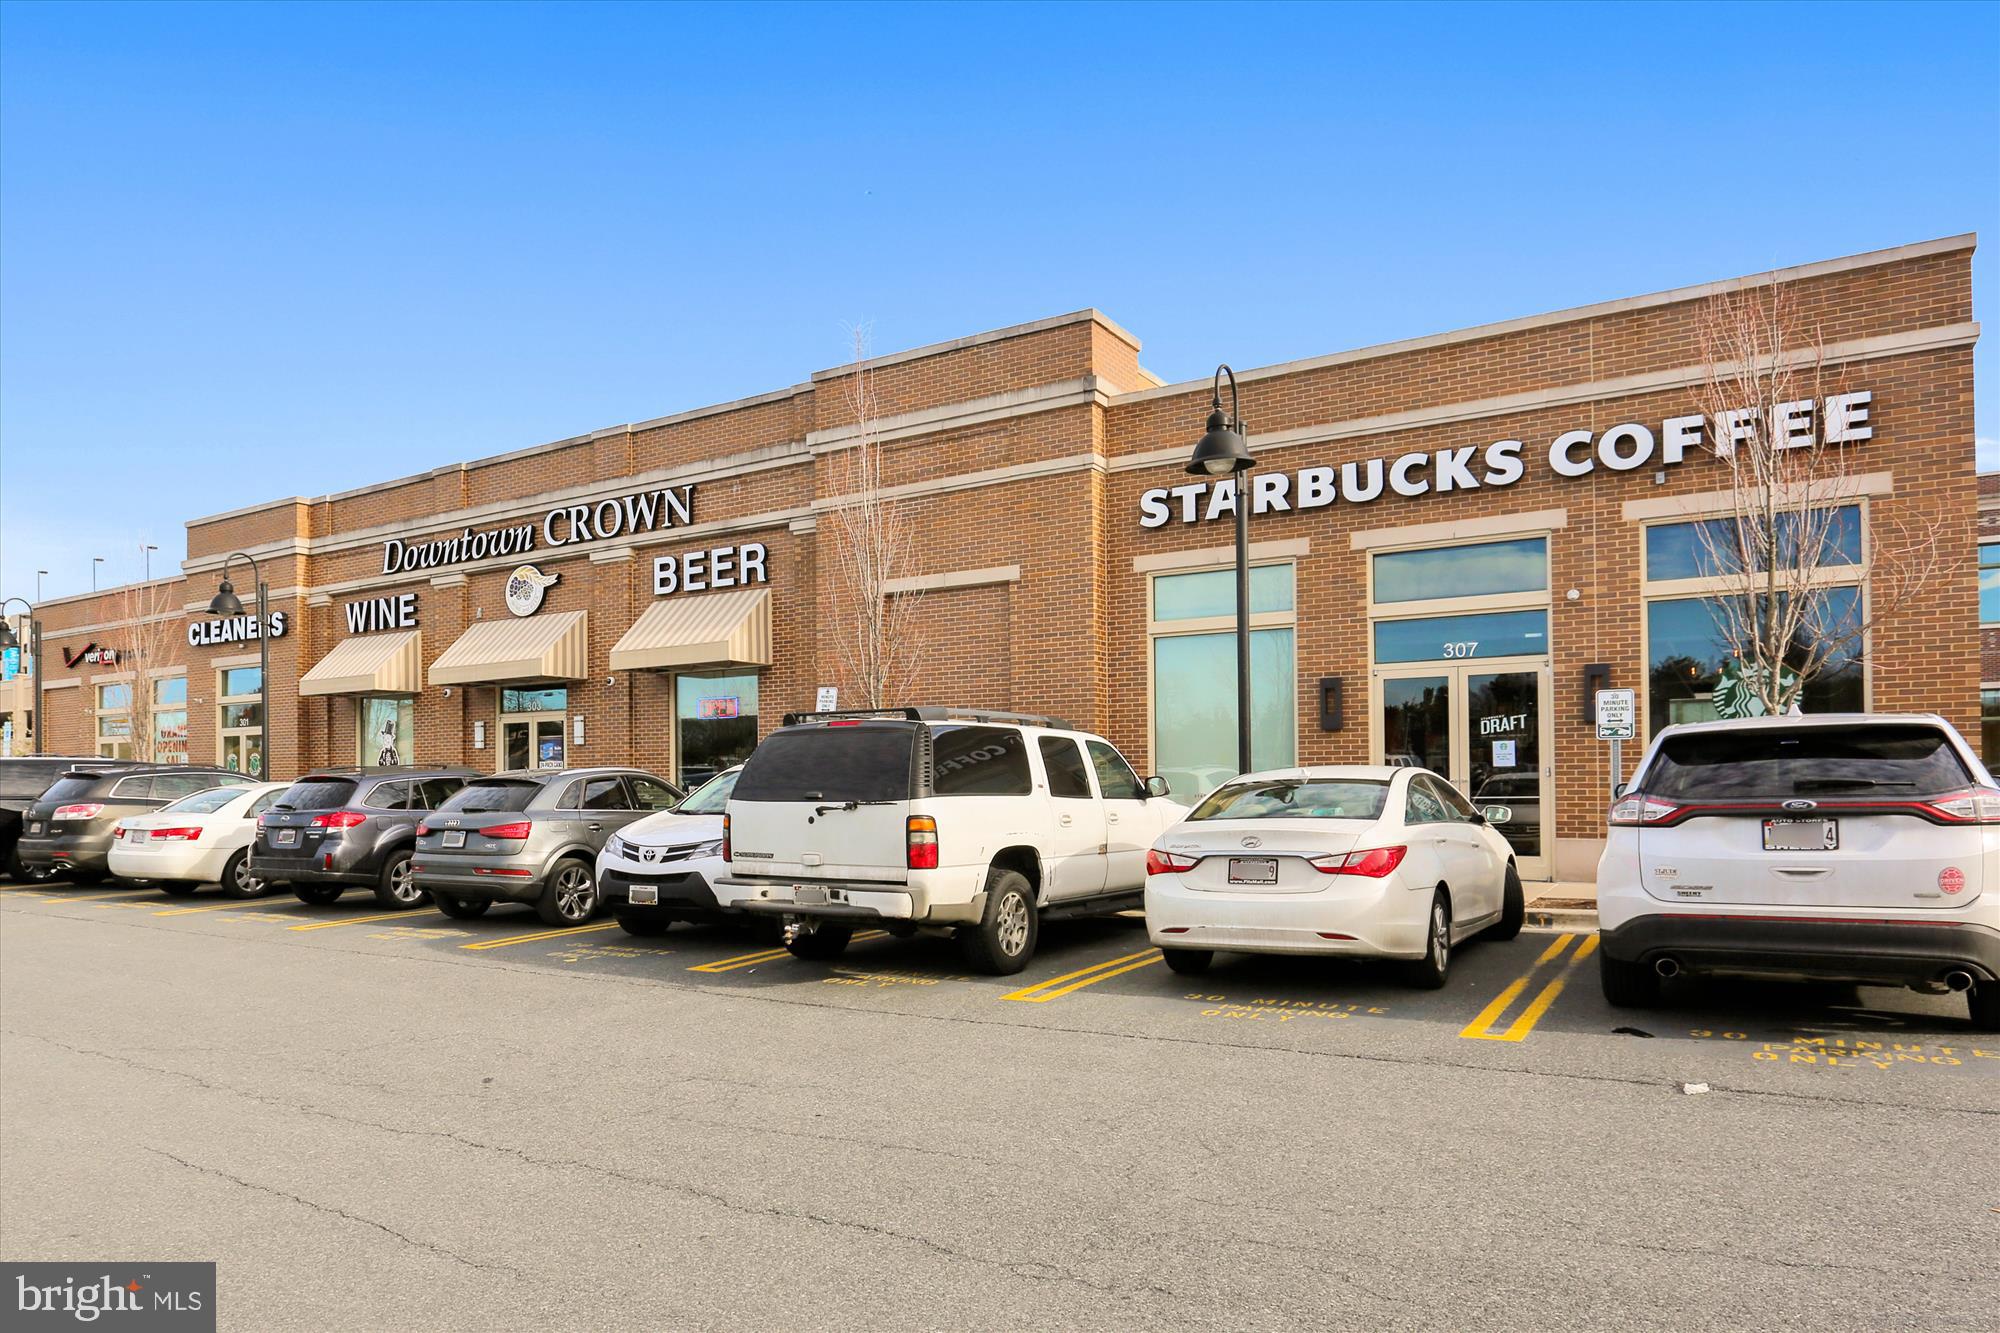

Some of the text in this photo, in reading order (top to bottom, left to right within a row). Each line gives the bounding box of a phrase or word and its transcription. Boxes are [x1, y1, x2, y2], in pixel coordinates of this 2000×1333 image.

[1139, 390, 1873, 528] STARBUCKS COFFEE
[381, 485, 695, 575] Downtown CROWN
[653, 542, 768, 596] BEER
[345, 593, 418, 634] WINE
[84, 648, 117, 664] verizon
[1442, 641, 1480, 659] 307
[527, 701, 542, 711] 303
[239, 718, 249, 727] 301
[1480, 713, 1528, 735] DRAFT
[1200, 1009, 1296, 1022] ONLY
[1218, 1003, 1351, 1019] PARKING
[1251, 998, 1391, 1014] MINUTE
[1761, 1042, 1962, 1066] PARKING
[1793, 1036, 2000, 1060] MINUTE
[1752, 1050, 1894, 1070] ONLY
